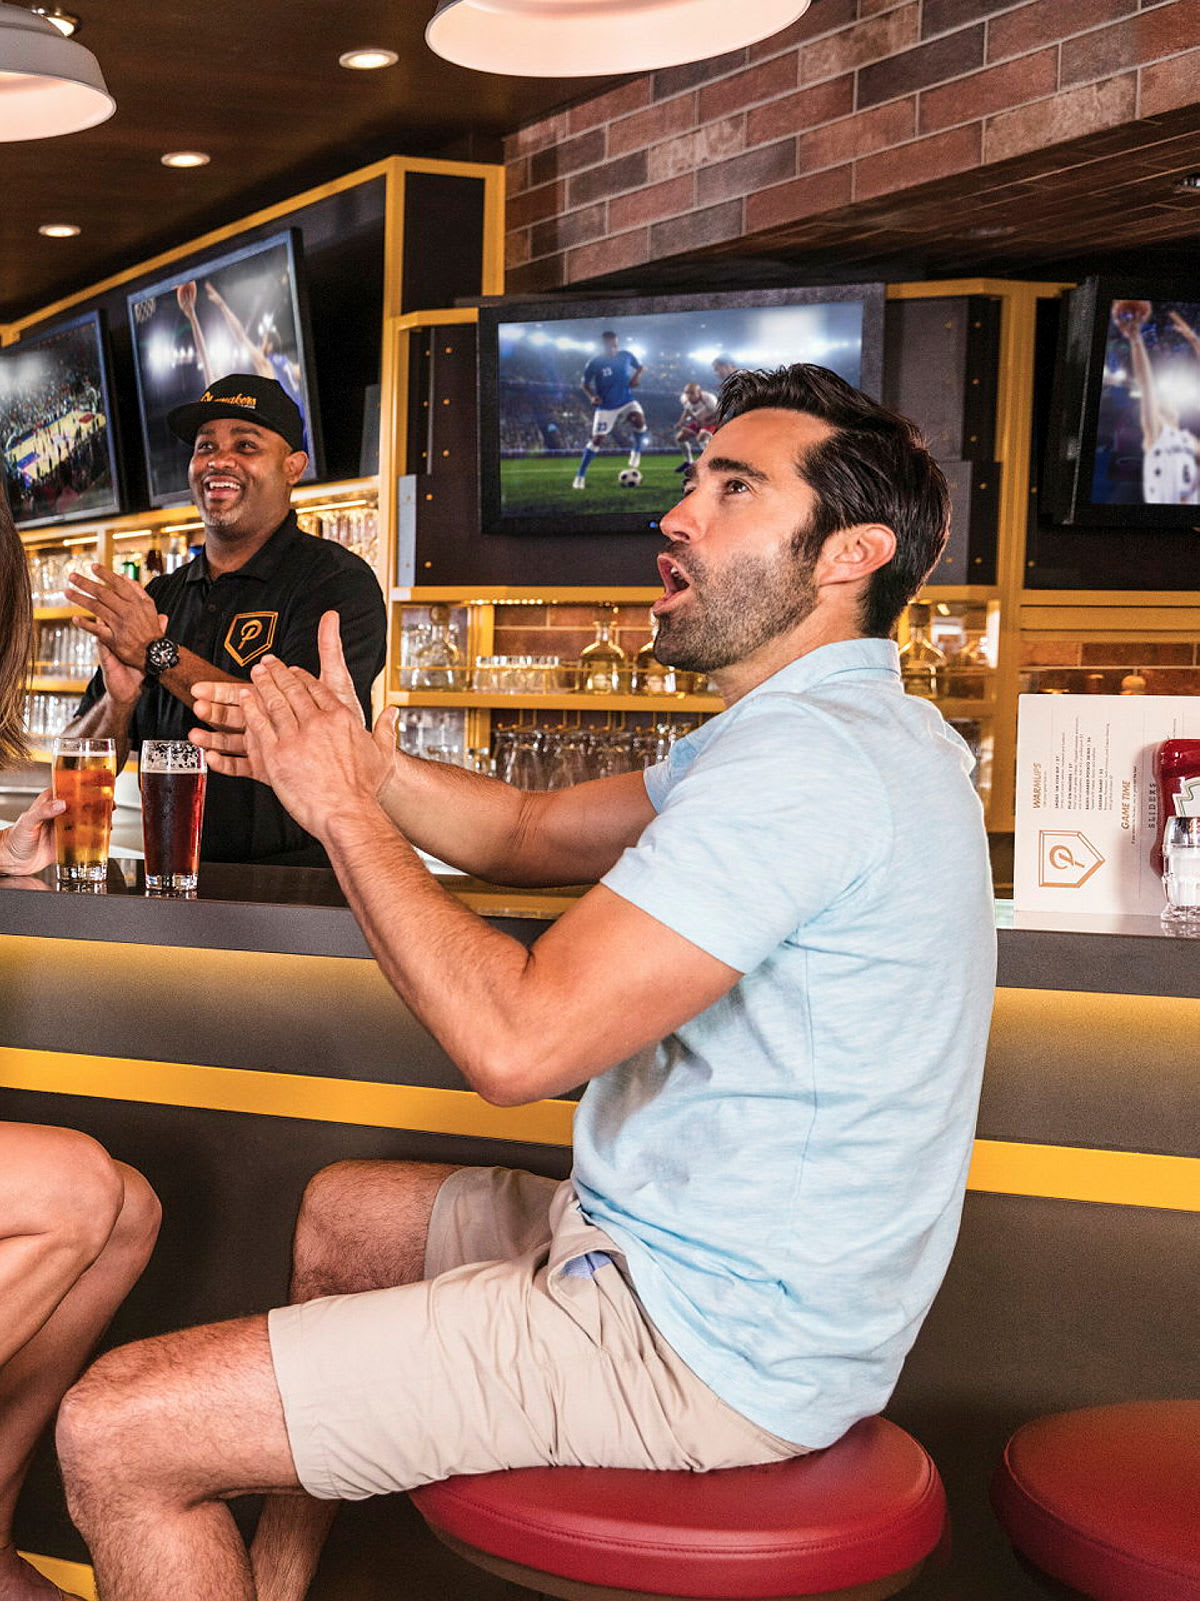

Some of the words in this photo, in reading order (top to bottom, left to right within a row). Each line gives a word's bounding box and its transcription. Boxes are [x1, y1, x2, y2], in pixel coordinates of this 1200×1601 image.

[1032, 762, 1042, 809] WARMUPS
[1122, 780, 1131, 801] TIME
[1120, 803, 1130, 830] GAME
